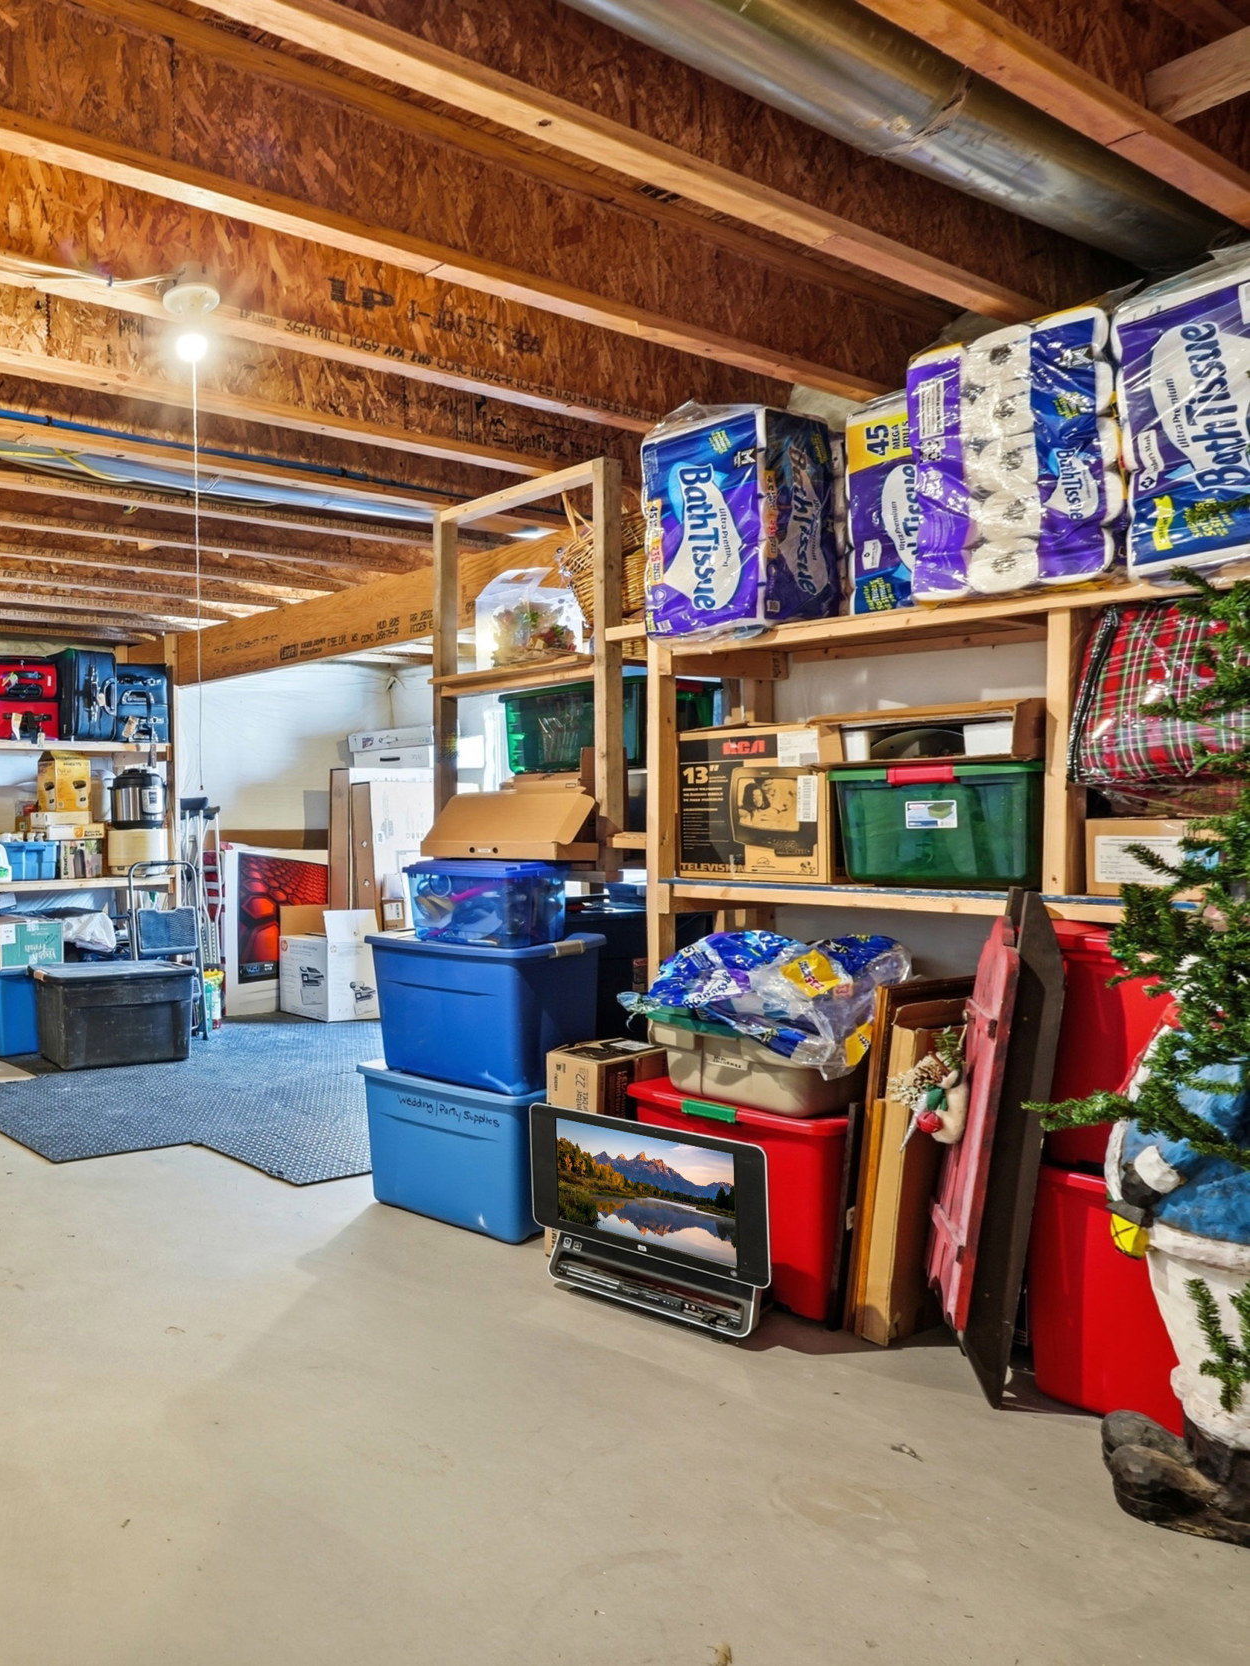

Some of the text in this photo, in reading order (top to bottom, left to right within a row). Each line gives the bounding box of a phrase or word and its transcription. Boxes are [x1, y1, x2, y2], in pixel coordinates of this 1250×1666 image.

[326, 276, 395, 311] LP
[283, 318, 312, 339] 36A
[313, 323, 345, 346] MILL
[349, 328, 380, 353] 1069
[384, 344, 407, 361] APA
[865, 424, 890, 456] 45
[891, 423, 900, 450] MEGA
[1171, 422, 1189, 450] Ultra
[719, 507, 728, 528] Ultra
[722, 739, 766, 756] RCA
[575, 1073, 586, 1088] 22
[438, 1104, 462, 1123] Party
[463, 1111, 501, 1128] Supplies
